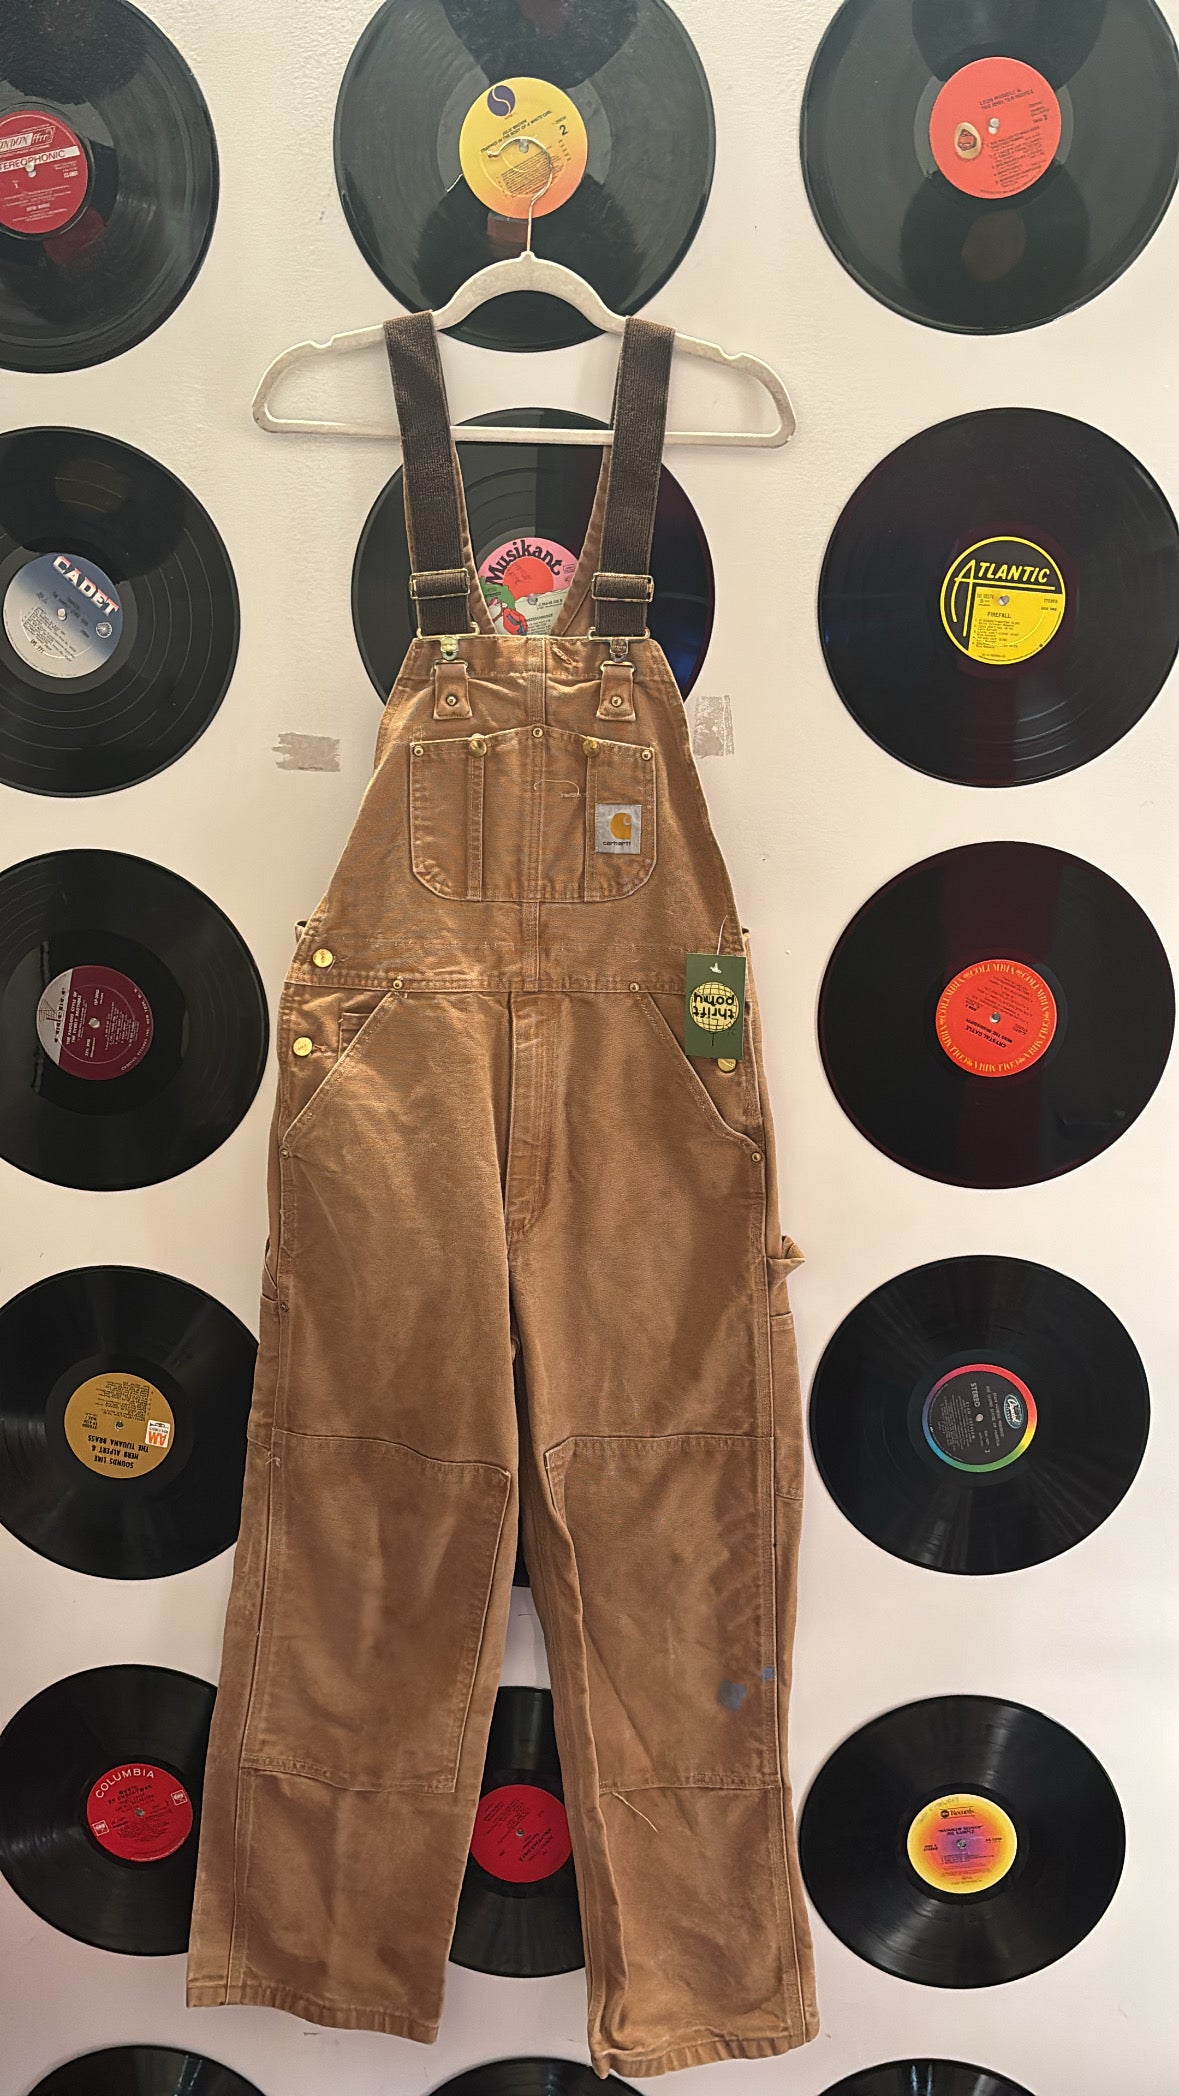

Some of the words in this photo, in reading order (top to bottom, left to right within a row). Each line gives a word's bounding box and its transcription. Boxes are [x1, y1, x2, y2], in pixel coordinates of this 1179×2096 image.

[557, 123, 569, 136] 2
[0, 150, 65, 170] TEREOPHONIC
[485, 540, 563, 586] Musikant
[53, 555, 120, 616] CADET
[968, 963, 1015, 977] COLUMBIA
[940, 978, 965, 1018] COLUMBIA
[1021, 972, 1049, 1011] COLUMBIA
[691, 1005, 734, 1020] thrift
[939, 1025, 968, 1063] COLUMBIA
[984, 1033, 1007, 1048] CRYSTAL
[1023, 1018, 1050, 1058] COLUMBIA
[974, 1058, 1020, 1072] COLUMBIA
[969, 1381, 980, 1407] STEREO
[1007, 1397, 1020, 1423] Capitol
[87, 1434, 107, 1444] BRASS
[108, 1438, 135, 1449] TIJUANA
[98, 1446, 120, 1456] ALPERT
[122, 1450, 139, 1459] HERB
[137, 1444, 149, 1453] THE
[93, 1454, 106, 1463] LIKE
[108, 1457, 134, 1468] SOUNDS
[95, 1768, 155, 1798] COLUMBIA
